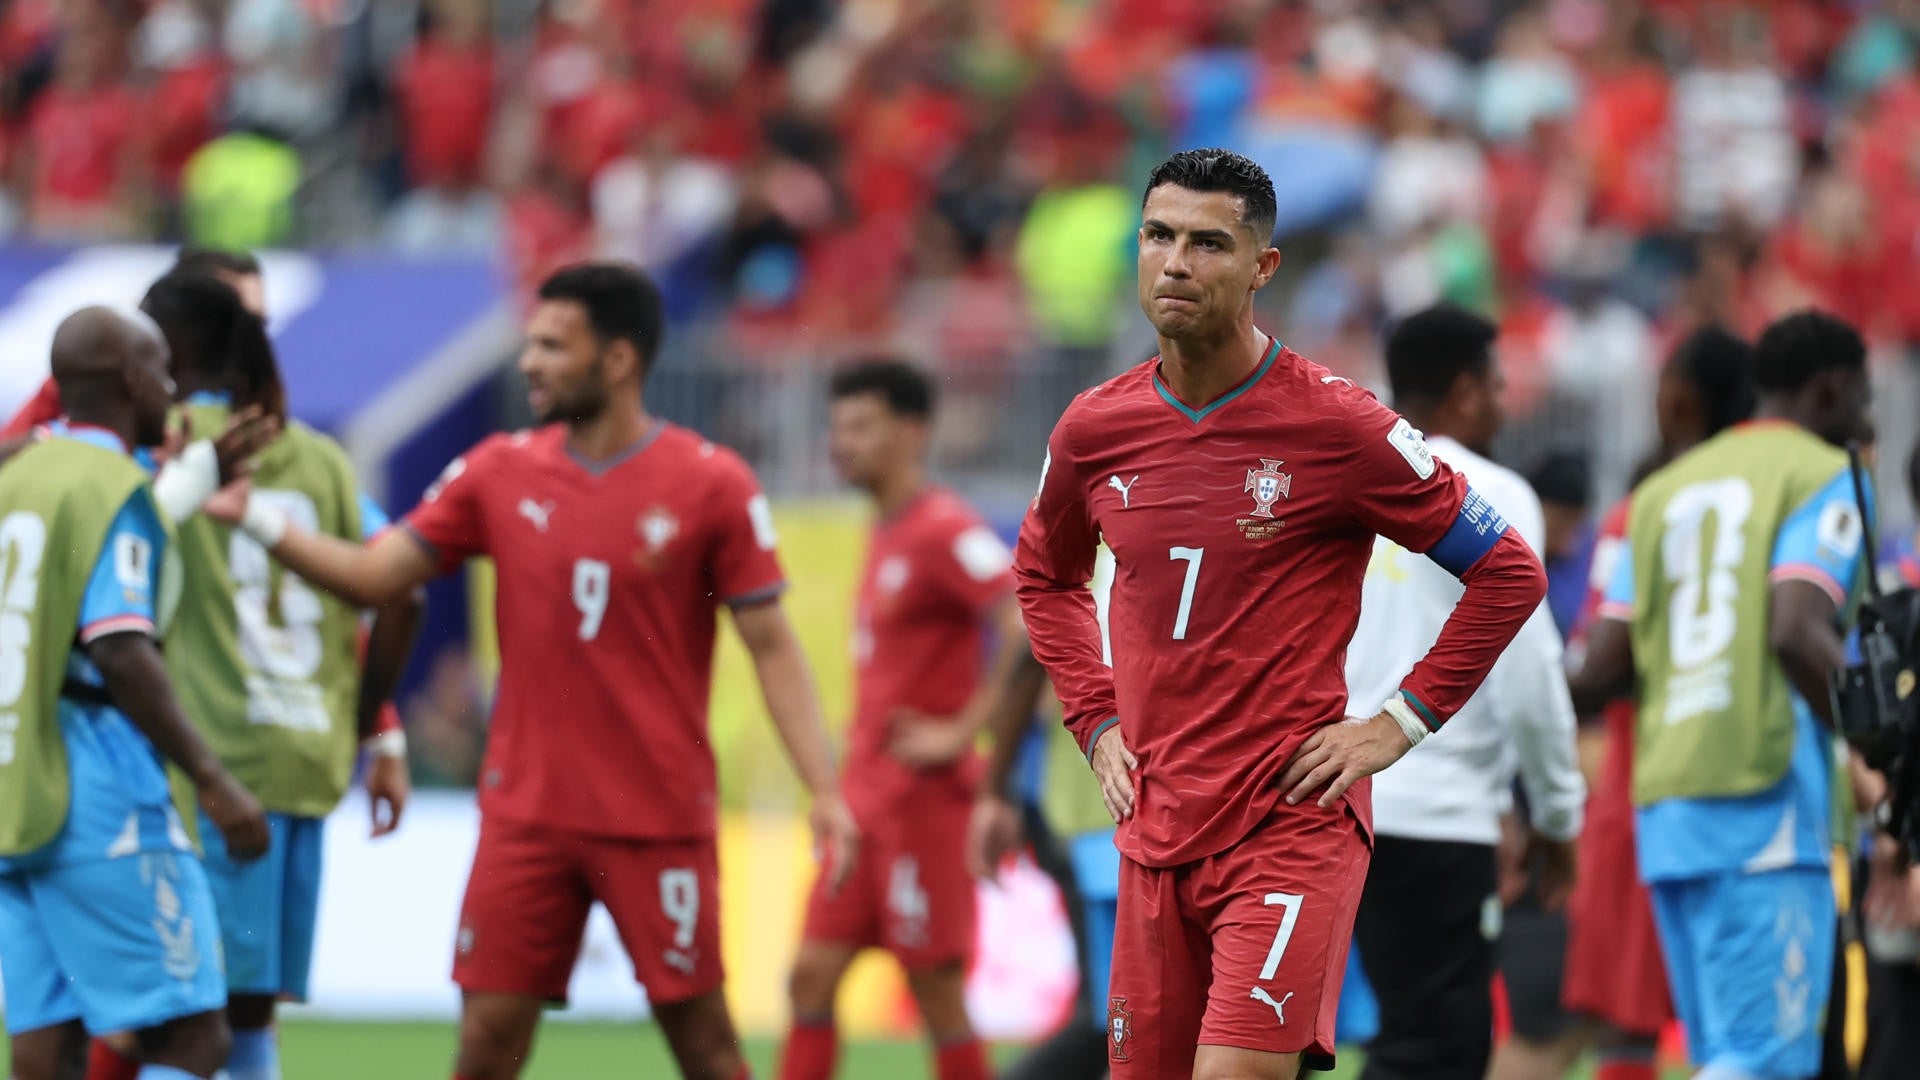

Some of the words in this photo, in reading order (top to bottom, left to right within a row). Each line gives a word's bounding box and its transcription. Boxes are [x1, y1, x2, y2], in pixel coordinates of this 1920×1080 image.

[572, 557, 612, 641] 9
[1169, 546, 1205, 640] 7
[658, 867, 700, 948] 9
[1258, 892, 1305, 980] 7
